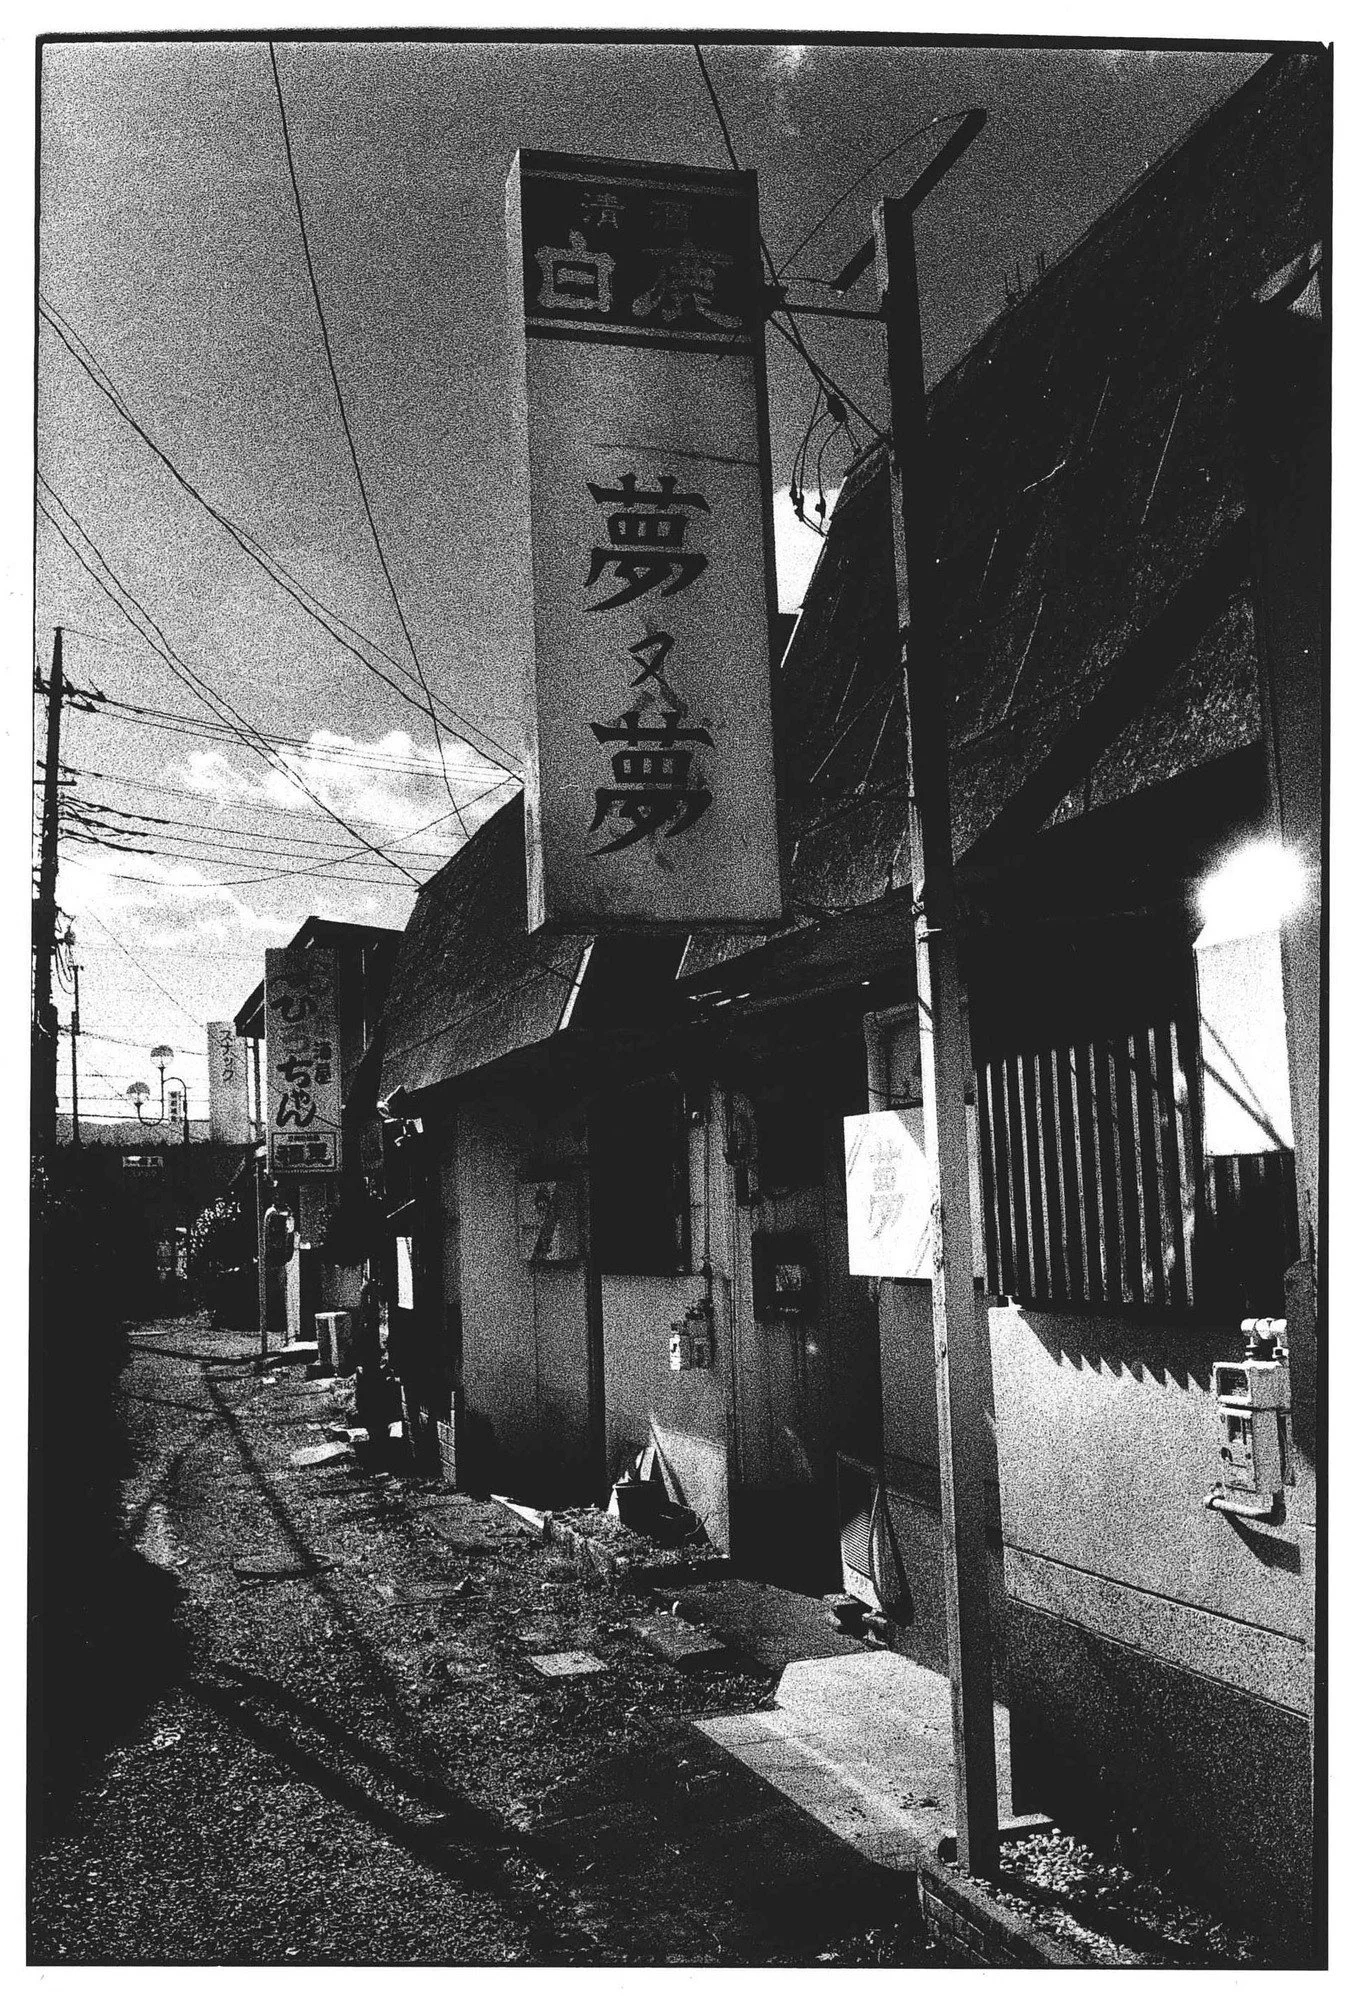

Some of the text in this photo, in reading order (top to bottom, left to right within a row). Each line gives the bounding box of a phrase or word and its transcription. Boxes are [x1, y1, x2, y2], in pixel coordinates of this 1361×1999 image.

[578, 191, 693, 232] 清酒
[533, 228, 744, 330] 白鹿
[583, 472, 716, 857] 夢又夢
[219, 1029, 235, 1083] スナック
[867, 1137, 906, 1240] 夢
